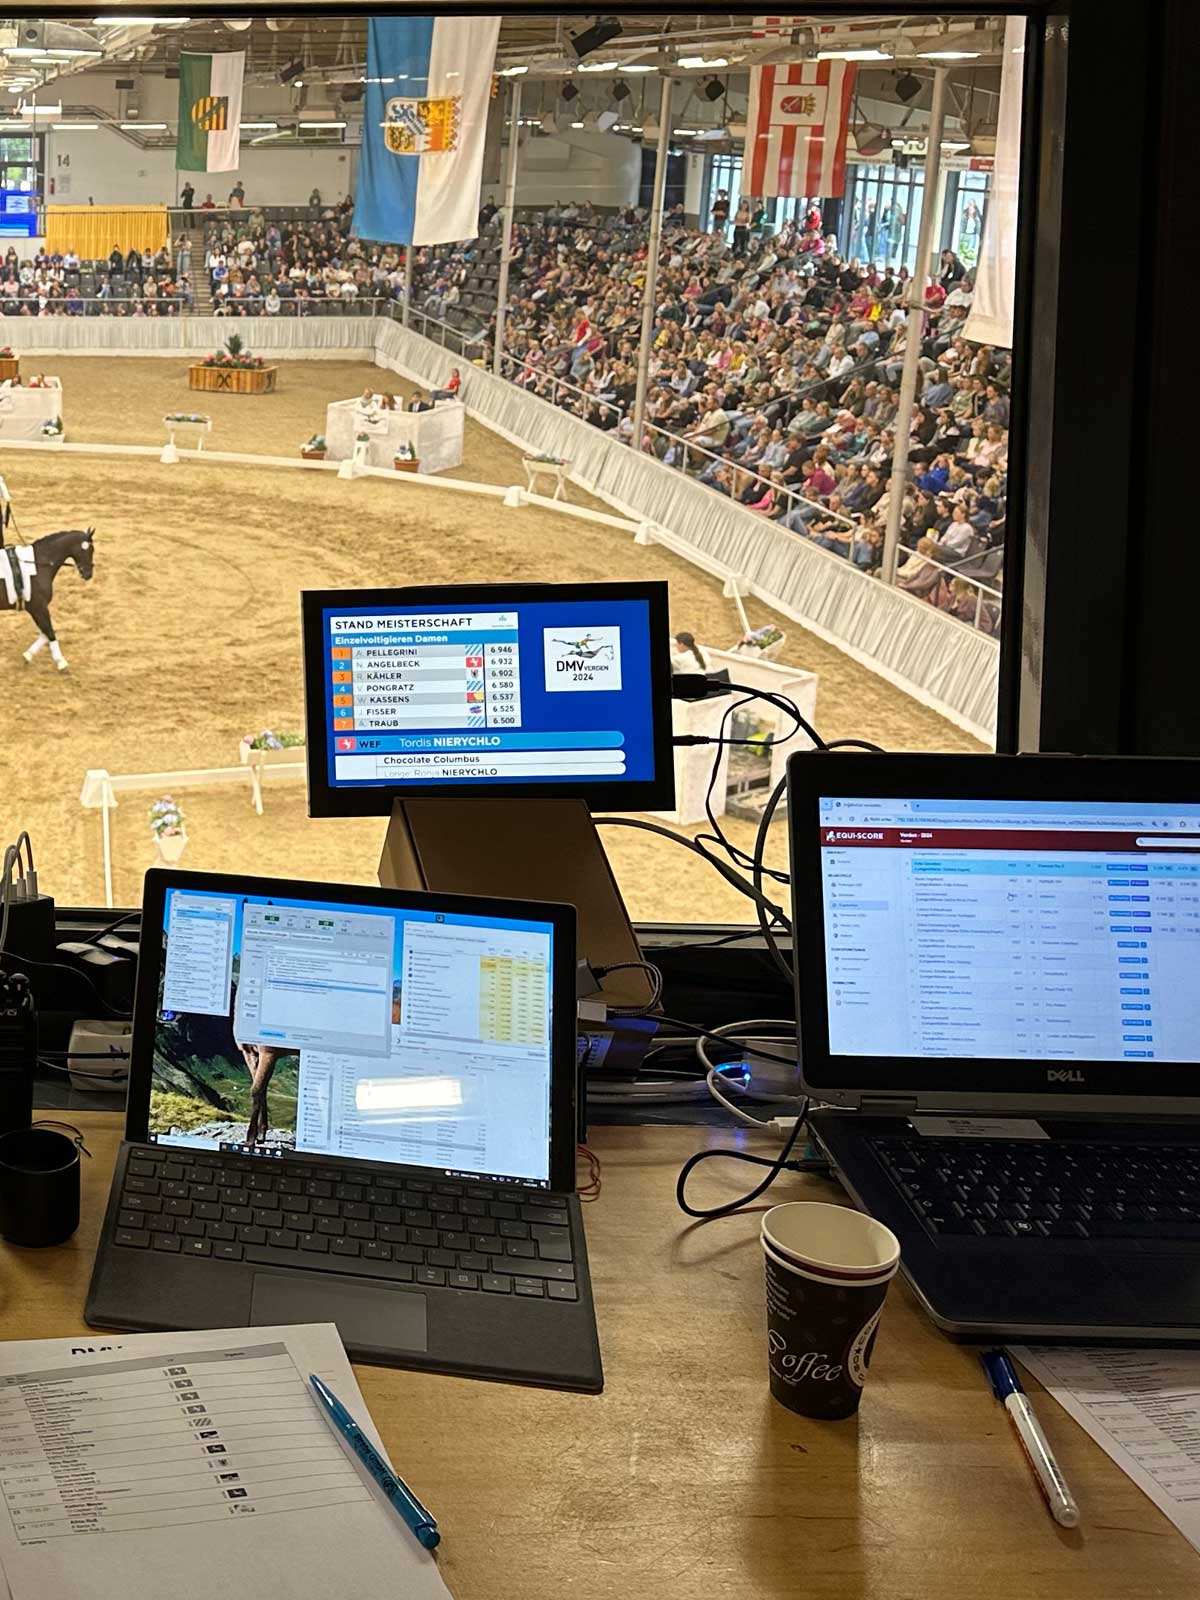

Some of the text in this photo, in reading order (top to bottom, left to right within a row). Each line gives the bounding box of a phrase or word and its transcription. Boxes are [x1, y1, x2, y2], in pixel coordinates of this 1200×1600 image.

[57, 154, 71, 167] 14
[335, 617, 473, 630] STAND MEISTERSCHAFT
[335, 634, 448, 645] Einzelvoltigieren Damen
[366, 649, 418, 657] PELLEGRINI
[367, 660, 420, 668] ANGELBECK
[556, 660, 584, 672] DMV
[366, 671, 402, 680] KÄHLER
[573, 673, 593, 681] 2024
[366, 684, 414, 692] PONGRATZ
[370, 696, 410, 704] KASSENS
[492, 693, 514, 701] 6.537
[366, 708, 397, 716] FISSER
[369, 719, 399, 727] TRAUB
[359, 740, 381, 748] WEF
[400, 736, 501, 748] Tordis NIERYCHLO
[383, 755, 480, 764] Chocolate Columbus
[442, 768, 498, 776] NIERYCHLO
[836, 832, 884, 841] EQUI-SCORE
[1047, 1069, 1085, 1083] DELL
[768, 1329, 843, 1383] Coffee
